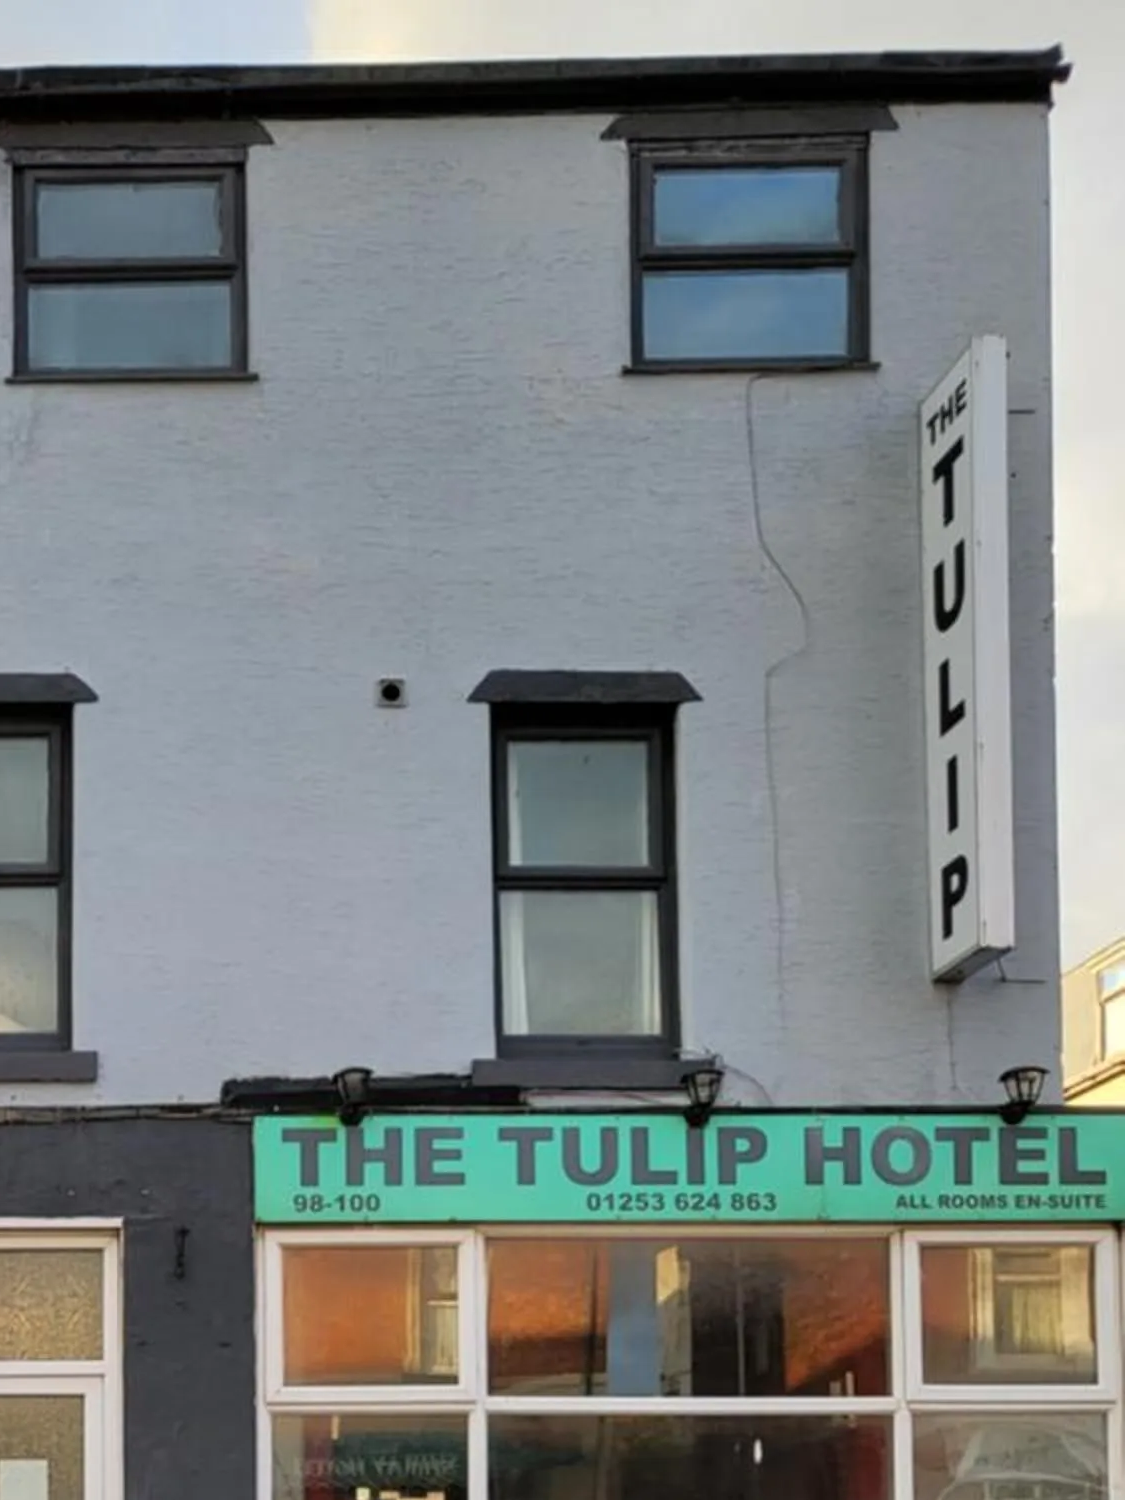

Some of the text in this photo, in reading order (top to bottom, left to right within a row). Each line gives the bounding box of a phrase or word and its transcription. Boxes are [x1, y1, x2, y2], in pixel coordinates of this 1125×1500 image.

[926, 378, 968, 446] THE
[932, 434, 969, 940] TULIP
[281, 1125, 1108, 1187] THE TULIP HOTEL
[293, 1193, 381, 1213] 98-100
[586, 1192, 777, 1212] 01253 624 863
[895, 1193, 1107, 1210] ALL ROOMS EN-SUITE
